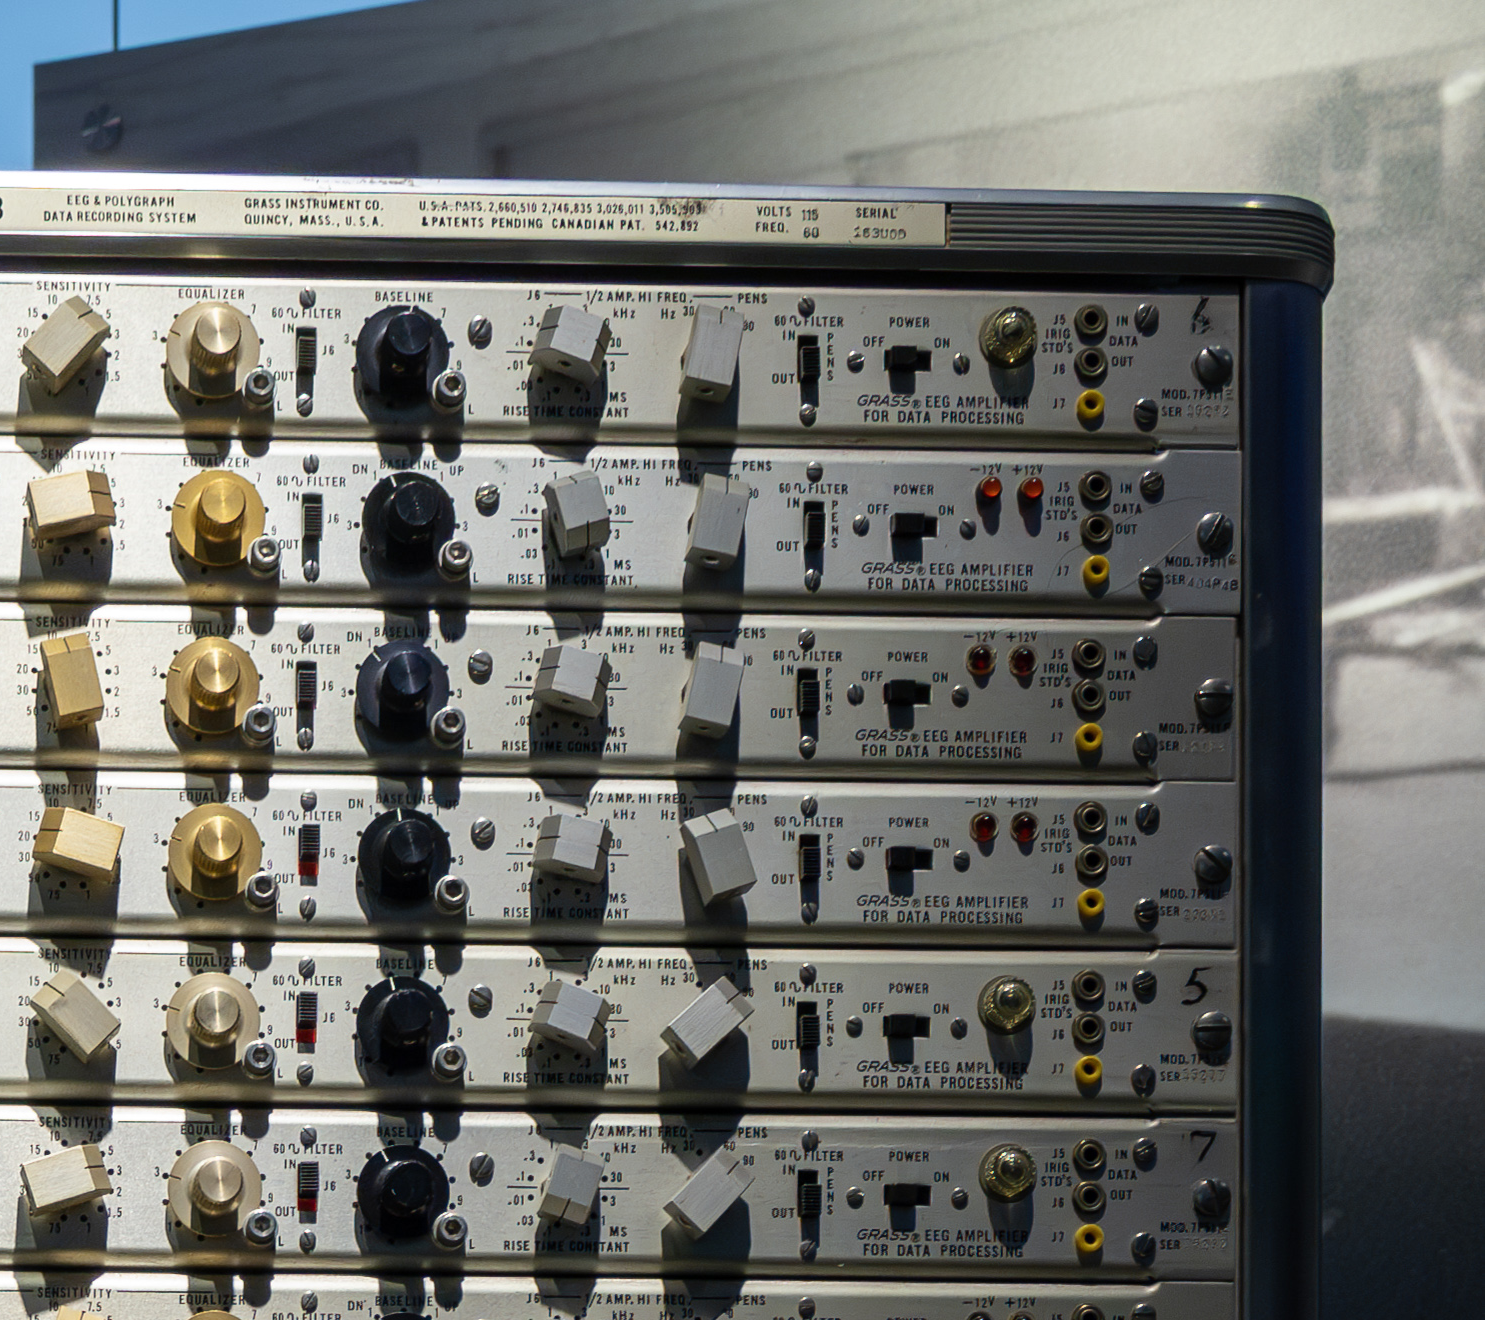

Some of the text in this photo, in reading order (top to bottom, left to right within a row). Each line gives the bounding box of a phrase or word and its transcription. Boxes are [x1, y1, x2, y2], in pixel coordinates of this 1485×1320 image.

[66, 195, 90, 207] EEG
[105, 195, 175, 208] POLYGRAPH
[244, 198, 282, 209] GRASS
[285, 198, 362, 211] INSTRUMENT
[43, 210, 197, 224] DATA RECORDING SYSTEM
[756, 206, 792, 218] VOLTS
[855, 207, 897, 220] SERIAL
[431, 217, 485, 228] PATENTS
[491, 217, 543, 229] PENDING
[551, 218, 614, 230] CANADIAN
[36, 280, 111, 292] SENSITIVITY
[177, 288, 246, 301] EQUALIZER
[374, 291, 434, 303] BASELINE
[738, 291, 768, 305] PENS
[302, 308, 342, 320] FILTER
[888, 316, 931, 329] POWER
[1044, 327, 1070, 341] IRIG
[863, 335, 885, 348] OFF
[934, 336, 950, 350] ON
[924, 394, 1029, 410] EEG AMPLIFIER
[863, 410, 1025, 426] FOR DATA PROCESSING
